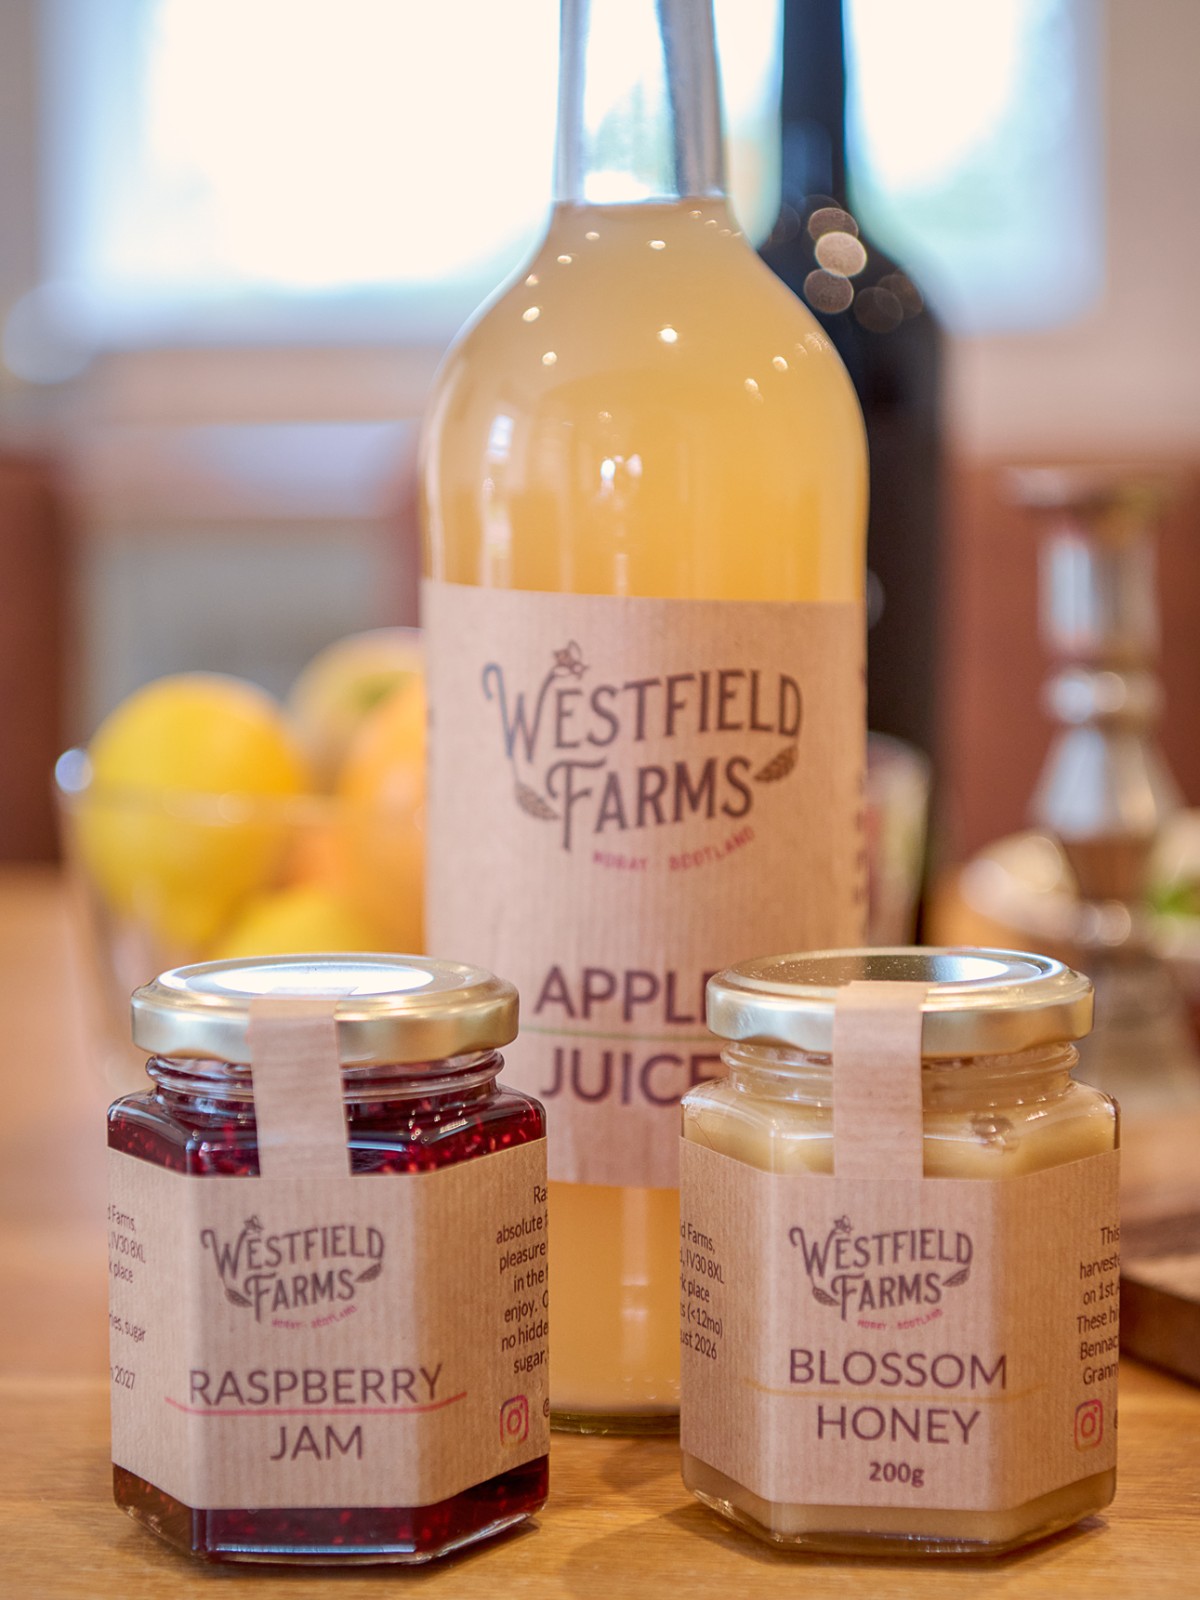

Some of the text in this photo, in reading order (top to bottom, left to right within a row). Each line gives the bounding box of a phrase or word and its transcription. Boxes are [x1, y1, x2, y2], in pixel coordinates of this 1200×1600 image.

[482, 662, 803, 763] WESTFIELD
[545, 756, 754, 851] FARMS
[533, 963, 711, 1026] APPL
[496, 1215, 543, 1245] absolute
[688, 1223, 716, 1255] Farms,
[201, 1224, 385, 1280] WESTFIELD
[500, 1242, 546, 1276] pleasure
[788, 1226, 974, 1278] WESTFIELD
[243, 1269, 355, 1324] FARMS
[514, 1275, 524, 1293] in
[526, 1268, 545, 1288] the
[688, 1279, 710, 1303] place
[831, 1272, 942, 1321] FARMS
[1083, 1289, 1096, 1306] on
[1100, 1281, 1114, 1301] 1st
[504, 1300, 538, 1323] enjoy.
[1077, 1312, 1107, 1334] These
[502, 1334, 516, 1352] no
[695, 1333, 717, 1360] 2026
[114, 1365, 136, 1391] 2027
[189, 1362, 442, 1406] RASPBERRY
[790, 1347, 1007, 1390] BLOSSOM
[817, 1405, 981, 1444] HONEY
[270, 1425, 363, 1461] JAM
[869, 1461, 925, 1488] 200g
